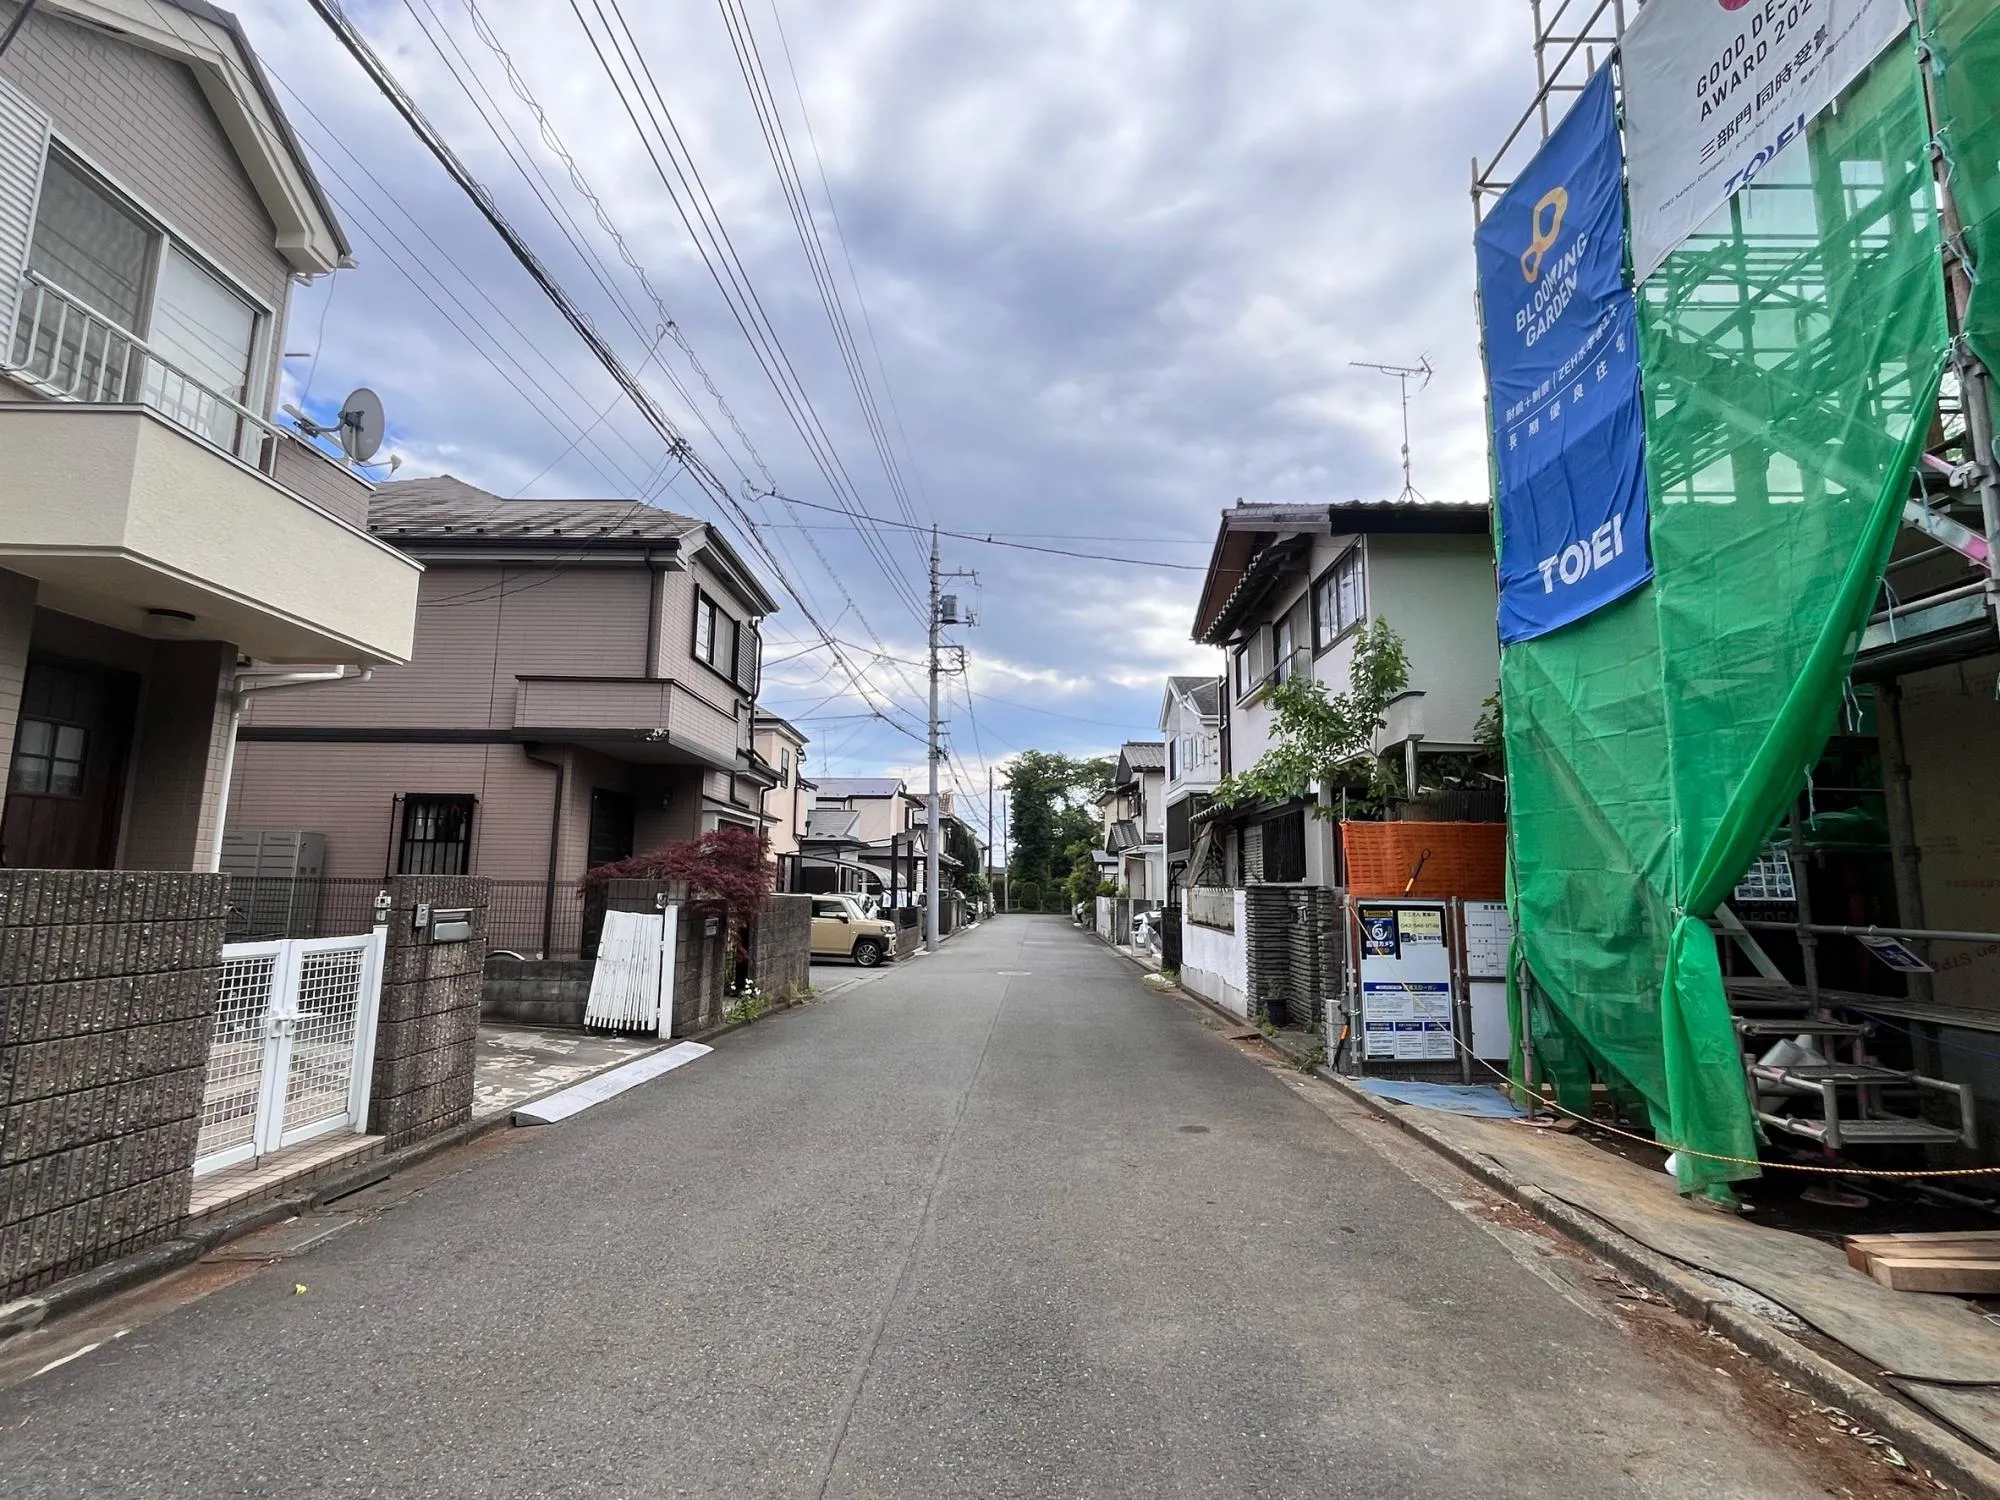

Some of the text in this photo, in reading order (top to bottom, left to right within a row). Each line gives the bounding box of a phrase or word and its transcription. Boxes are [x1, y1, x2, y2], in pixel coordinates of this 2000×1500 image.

[1696, 33, 1745, 98] GOOD
[1700, 40, 1767, 122] AWARD
[1699, 102, 1752, 165] 三部門
[1515, 232, 1589, 333] BLOOMING
[1525, 269, 1578, 348] GARDEN
[1537, 512, 1624, 595] TOEI
